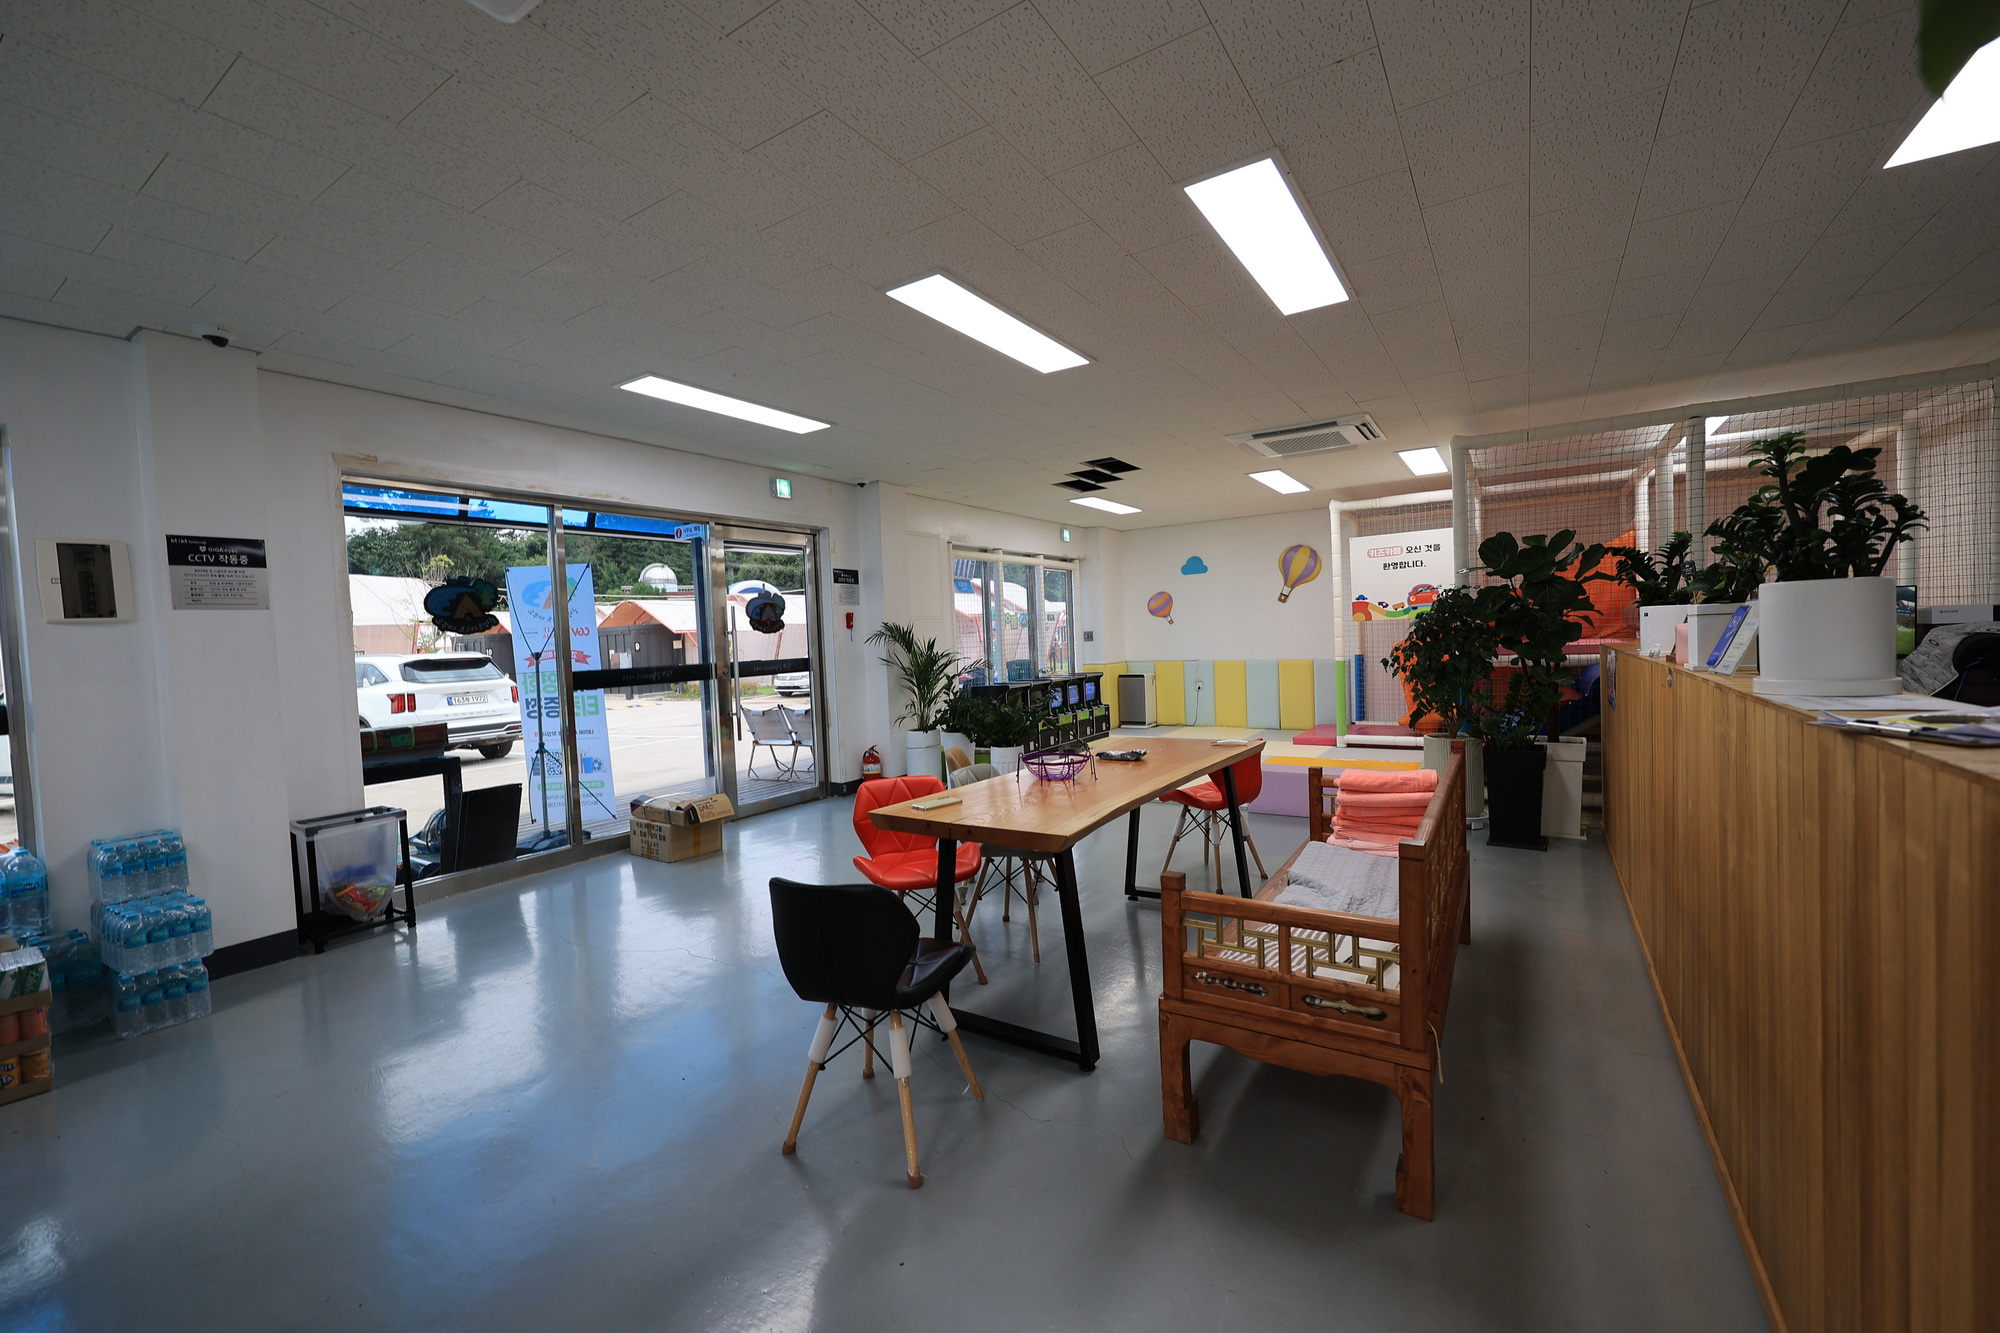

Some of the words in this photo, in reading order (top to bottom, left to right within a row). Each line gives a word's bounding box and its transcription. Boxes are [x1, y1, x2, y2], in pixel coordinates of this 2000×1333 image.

[1405, 545, 1422, 554] 오신
[1424, 543, 1441, 553] 것을
[188, 554, 216, 563] CCTV
[218, 554, 249, 565] 작동중
[1382, 560, 1427, 571] 환영합니다.
[486, 648, 493, 656] 10
